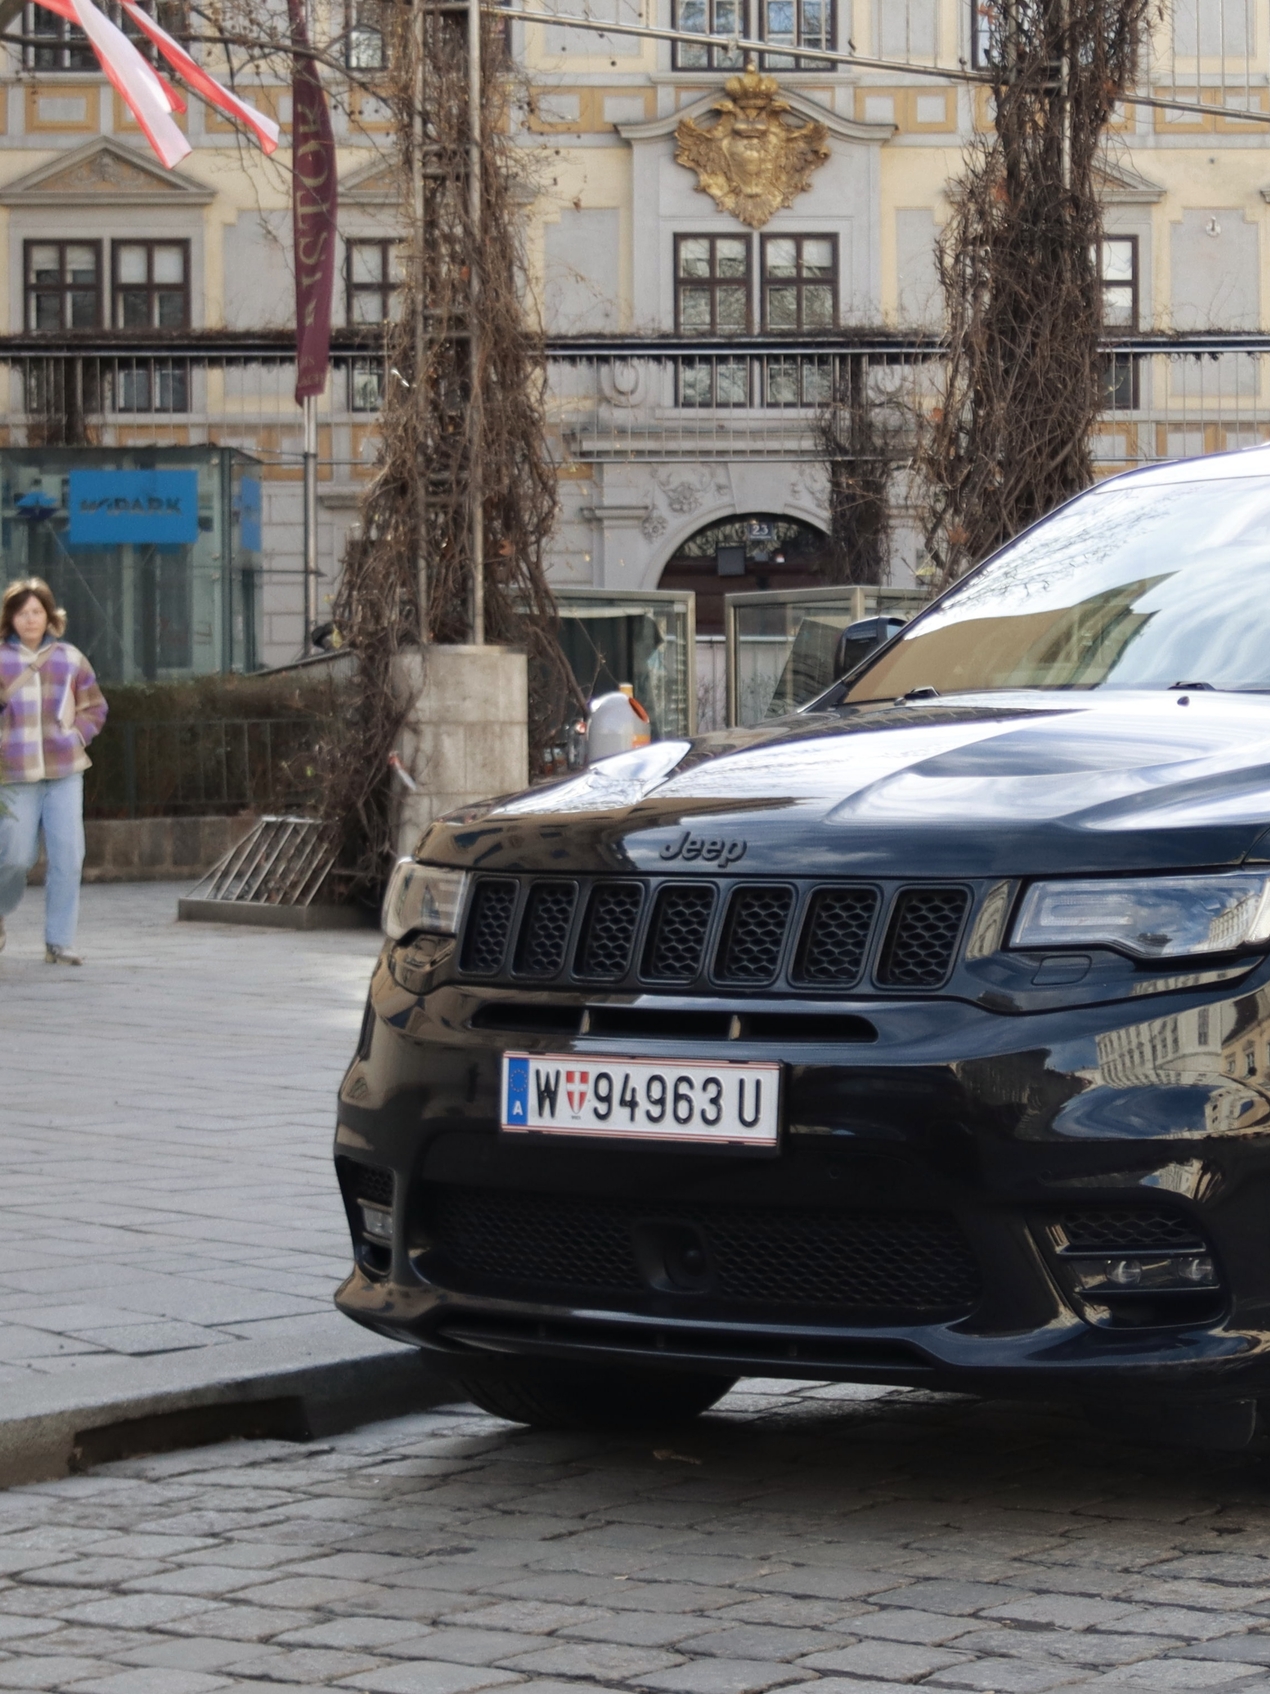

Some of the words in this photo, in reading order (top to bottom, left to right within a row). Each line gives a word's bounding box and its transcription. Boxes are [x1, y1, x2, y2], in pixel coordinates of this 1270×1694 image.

[659, 831, 747, 868] Jeep
[513, 1100, 524, 1116] A
[535, 1068, 562, 1118] W
[593, 1071, 723, 1126] 94963
[738, 1077, 762, 1128] U
